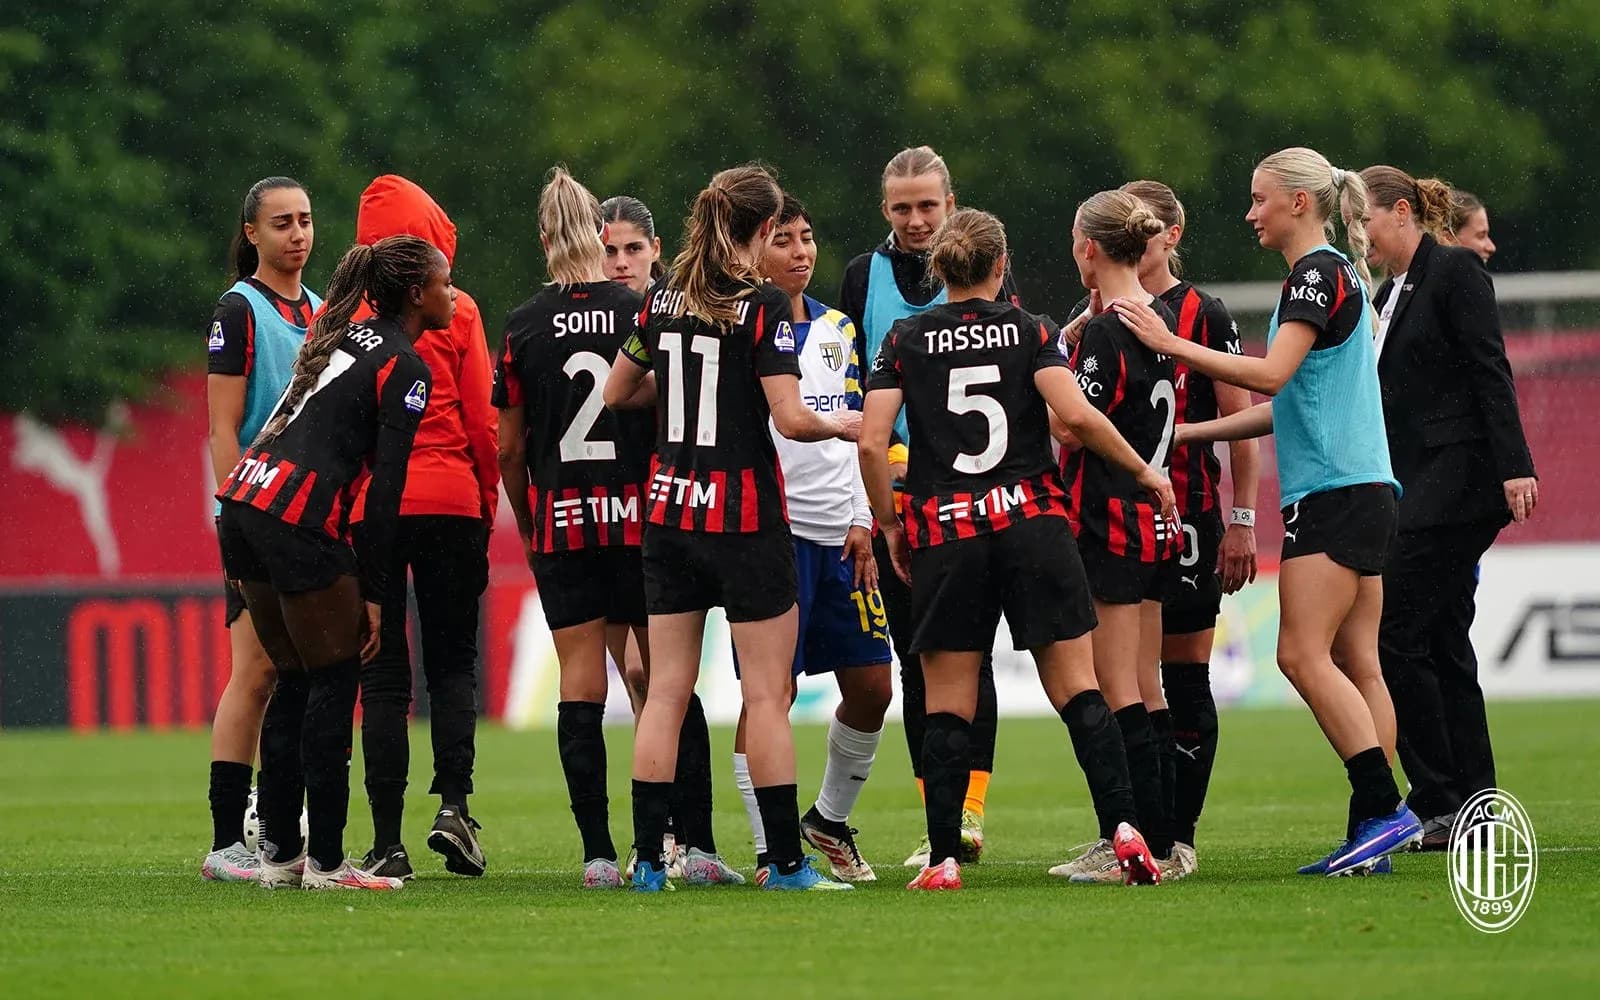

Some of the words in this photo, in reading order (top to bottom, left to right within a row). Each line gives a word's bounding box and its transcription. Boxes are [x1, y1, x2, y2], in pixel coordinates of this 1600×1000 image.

[1289, 285, 1328, 308] MSC
[553, 311, 615, 338] SOINI
[924, 323, 1020, 354] TASSAN
[658, 332, 720, 446] 11
[559, 351, 617, 462] 2
[947, 364, 1009, 475] 5
[238, 458, 281, 490] TIM
[673, 477, 717, 509] TIM
[974, 484, 1028, 516] TIM
[587, 497, 638, 523] TIM
[851, 589, 888, 632] 19
